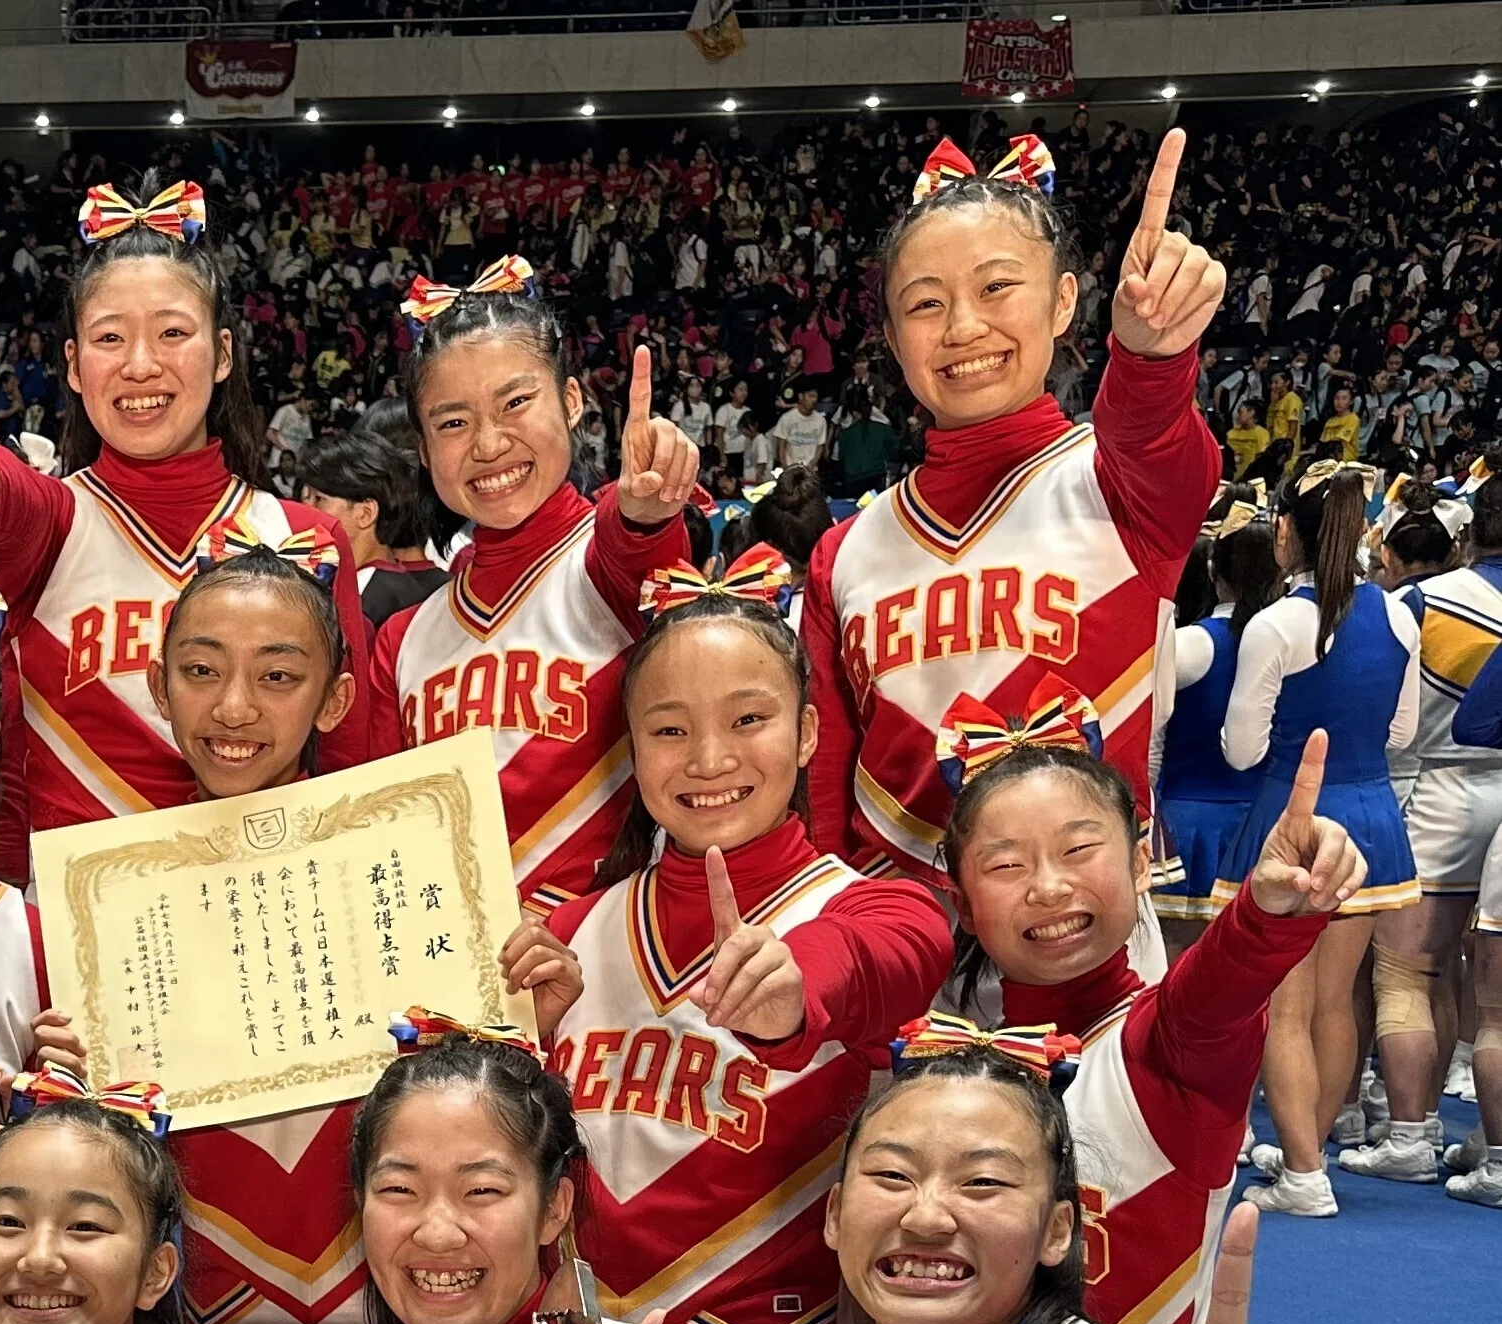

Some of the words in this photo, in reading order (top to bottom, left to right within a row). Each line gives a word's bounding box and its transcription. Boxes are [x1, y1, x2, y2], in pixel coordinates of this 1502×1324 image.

[64, 598, 174, 697] BE
[841, 565, 1080, 713] BEARS
[199, 881, 213, 914] ます
[305, 858, 344, 1041] 貴チームは日本選手権大
[366, 863, 400, 978] 最高得点賞
[420, 883, 455, 960] 賞状
[250, 870, 279, 985] 得いたしました
[271, 998, 287, 1052] よってこ
[277, 866, 317, 1046] 会において最高得点を獲
[354, 1012, 375, 1027] 殿
